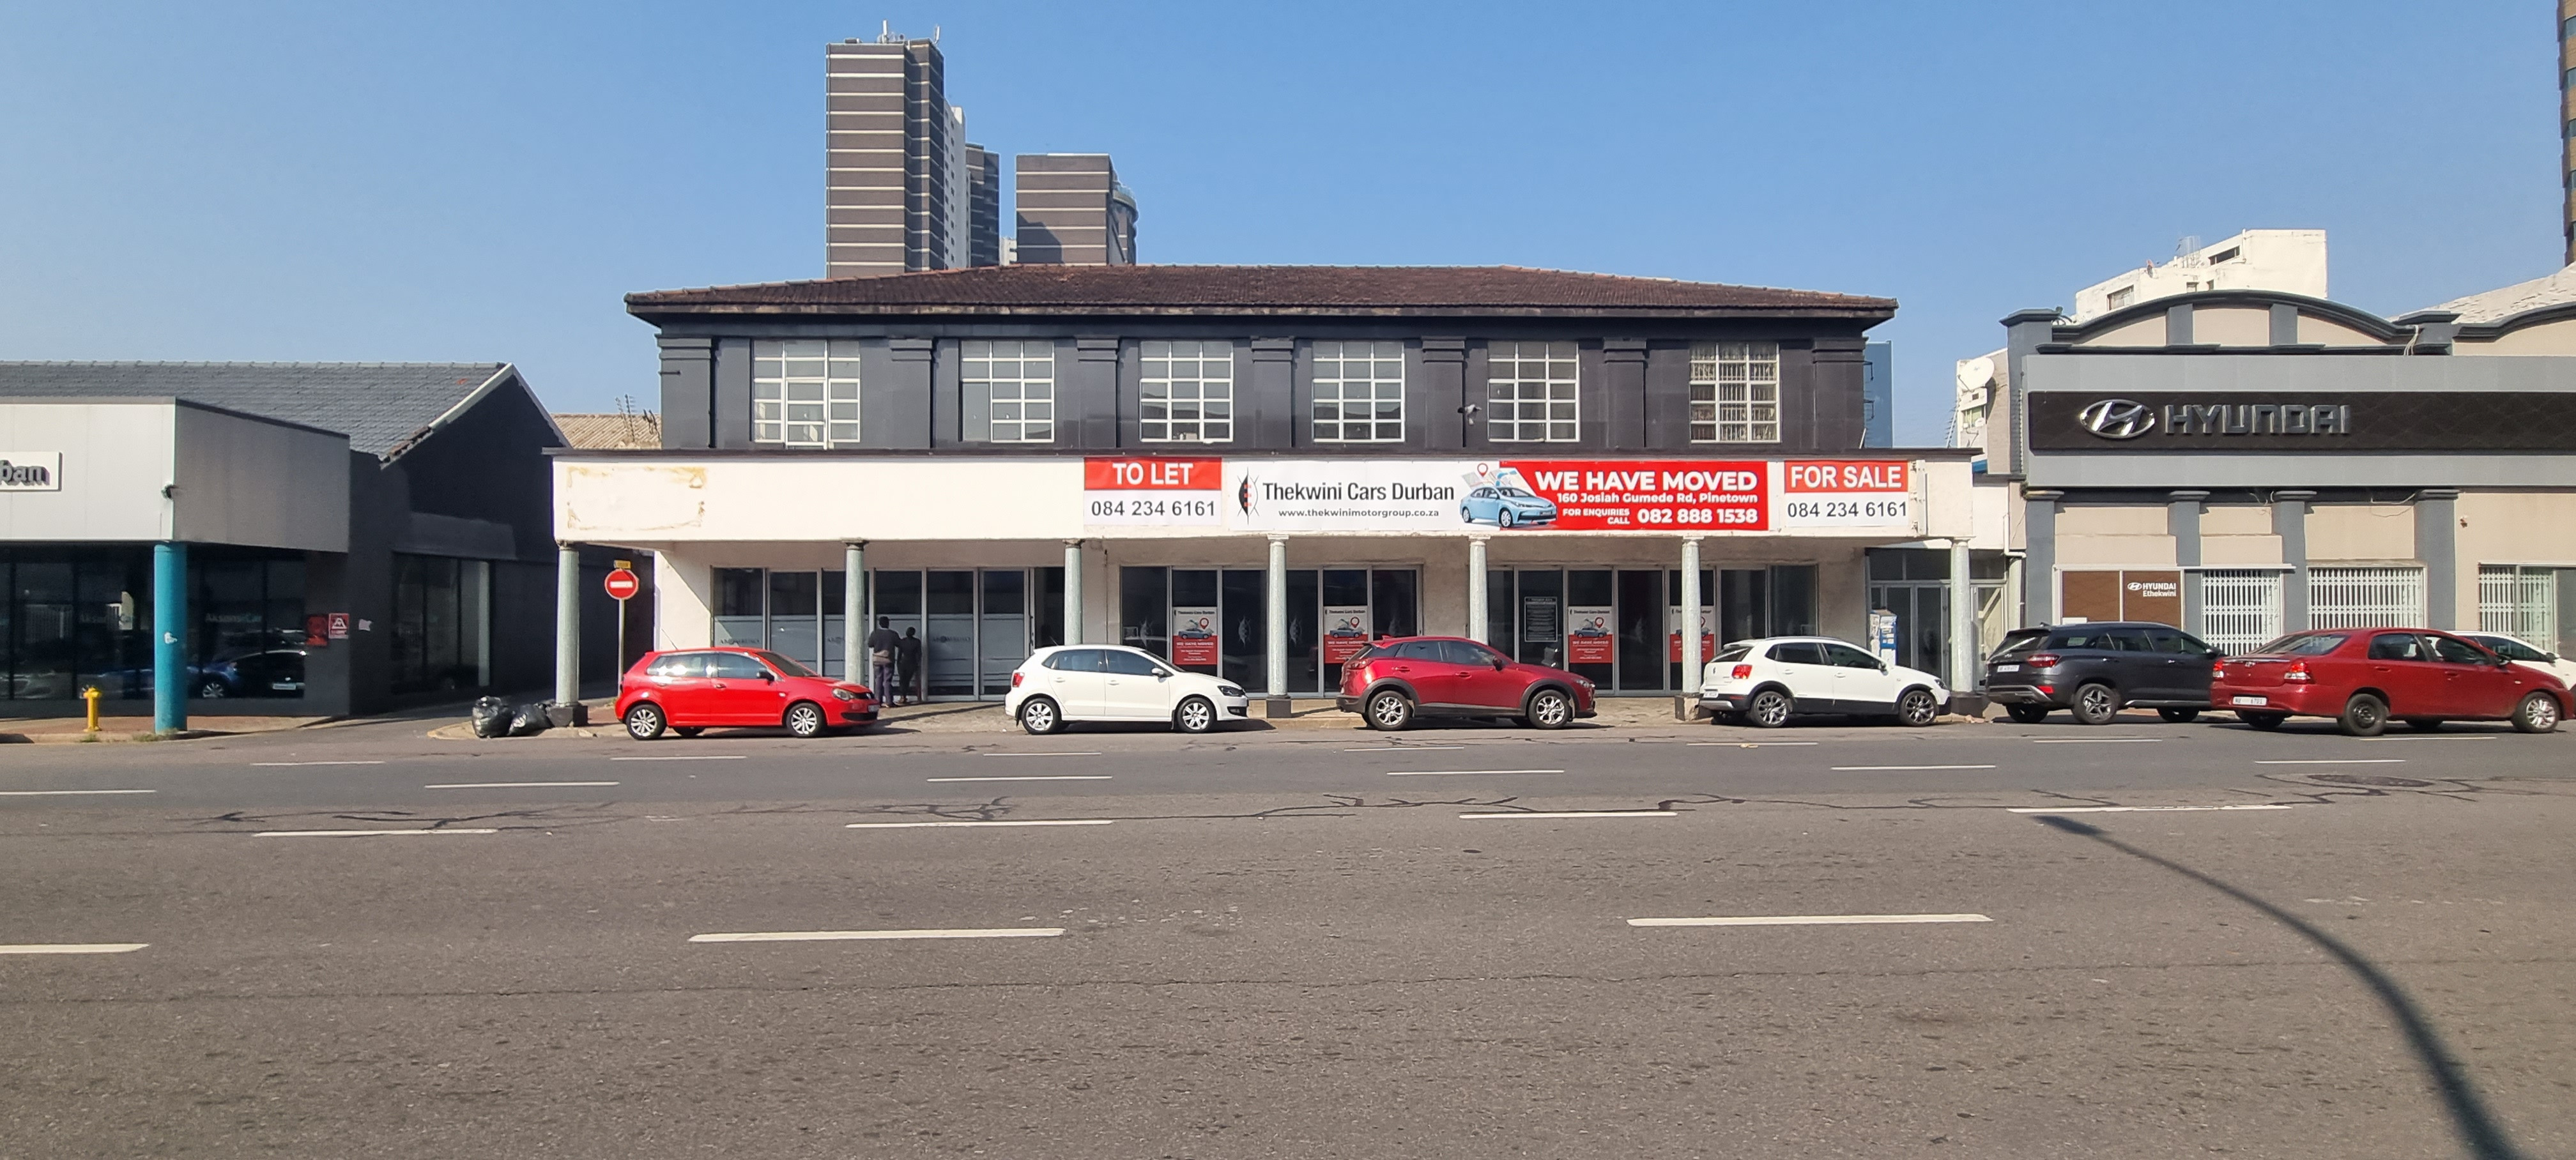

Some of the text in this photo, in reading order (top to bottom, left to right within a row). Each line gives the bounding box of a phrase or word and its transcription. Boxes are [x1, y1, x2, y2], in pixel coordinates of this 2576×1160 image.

[2165, 404, 2351, 434] HYUNDAI
[1112, 462, 1193, 485] TO LET
[1535, 471, 1758, 491] WE HAVE MOVED
[1791, 466, 1902, 488] FOR SALE
[1262, 482, 1455, 500] Thekwini Cars Durban
[1557, 492, 1758, 505] 160 Josiah Gumede Rd, Pinetown
[1091, 501, 1215, 516] 084 234 6161
[1278, 508, 1439, 518] www.thekwinimotorgroup.co.za
[1583, 508, 1630, 517] ENQUIRIES
[1637, 508, 1758, 524] 082 888 1538
[1788, 501, 1906, 517] 084 234 6161
